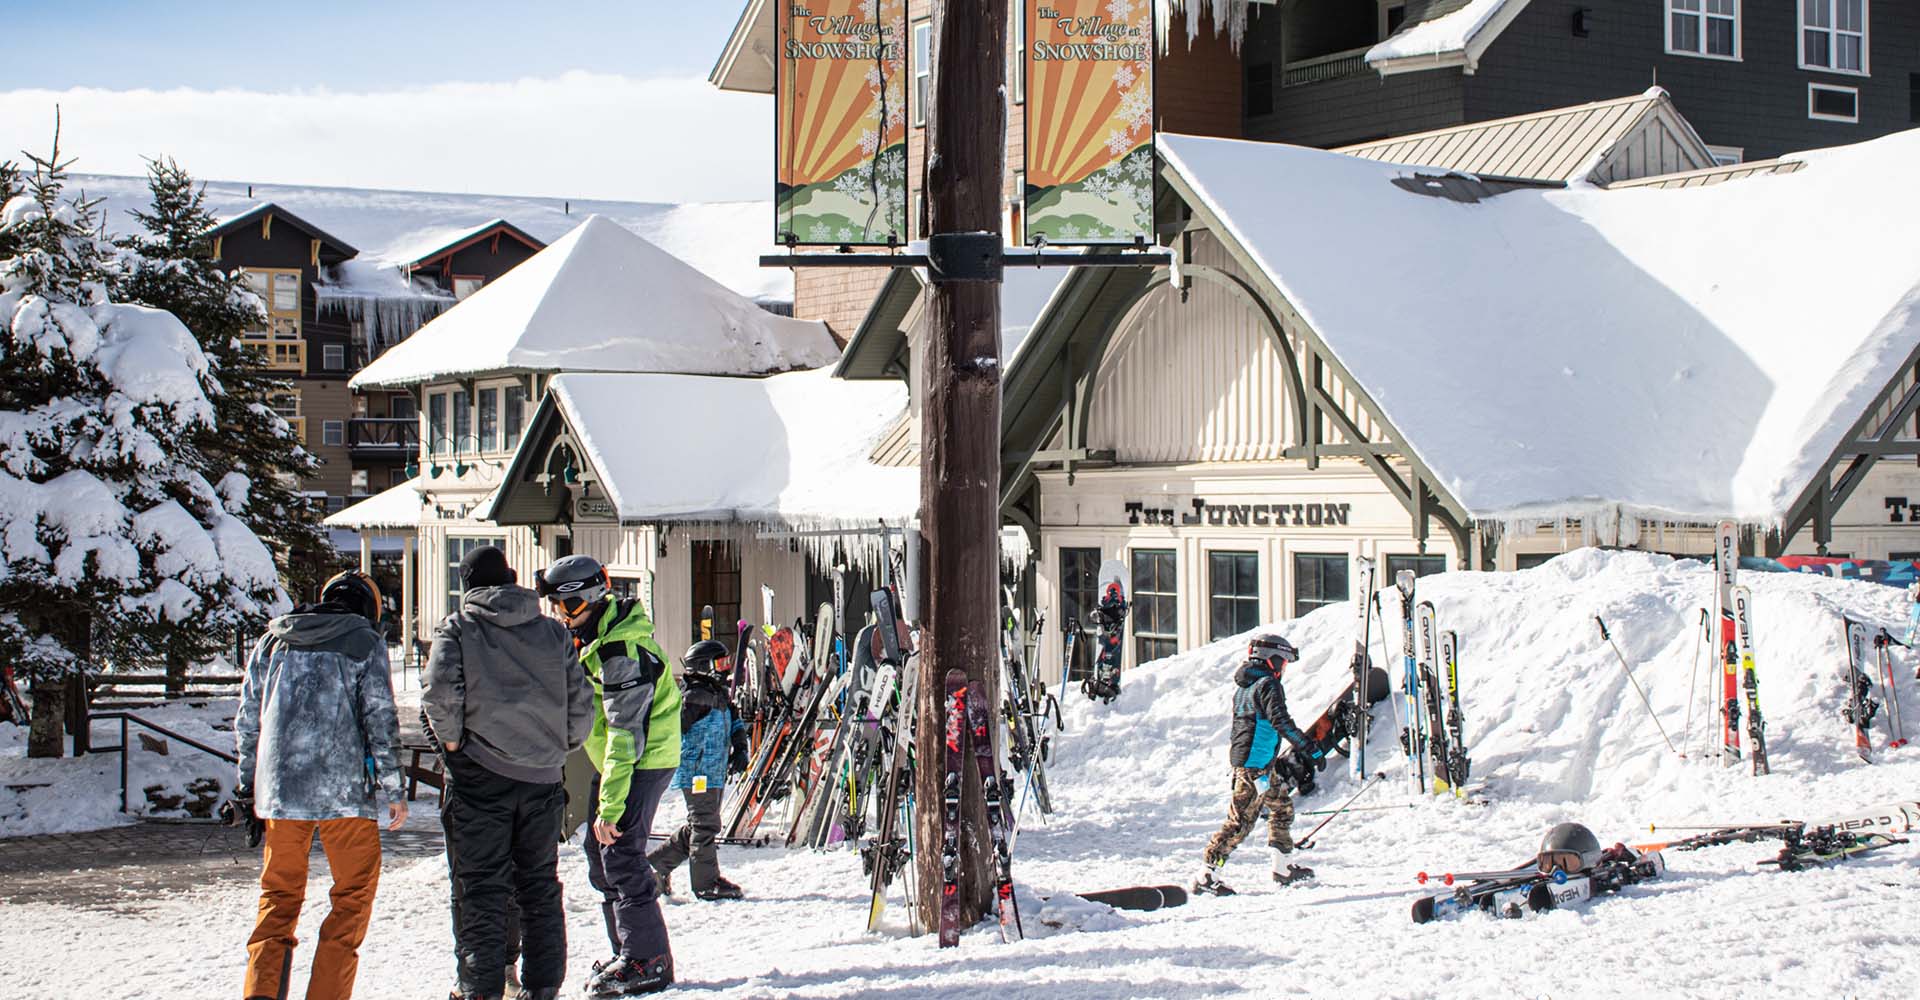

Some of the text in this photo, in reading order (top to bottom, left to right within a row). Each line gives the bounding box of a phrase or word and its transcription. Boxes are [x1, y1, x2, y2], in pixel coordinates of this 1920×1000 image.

[791, 6, 812, 17] The
[1038, 7, 1060, 18] The
[809, 15, 880, 41] Village
[1057, 16, 1141, 42] Village at
[785, 39, 898, 59] SNOWSHOE
[1033, 40, 1147, 61] SNOWSHOE
[1125, 498, 1351, 526] THE JUNCTION
[1737, 598, 1750, 649] HEAD
[1422, 616, 1432, 660] HEAD
[1443, 644, 1455, 690] HEAD
[874, 674, 889, 708] HEAD
